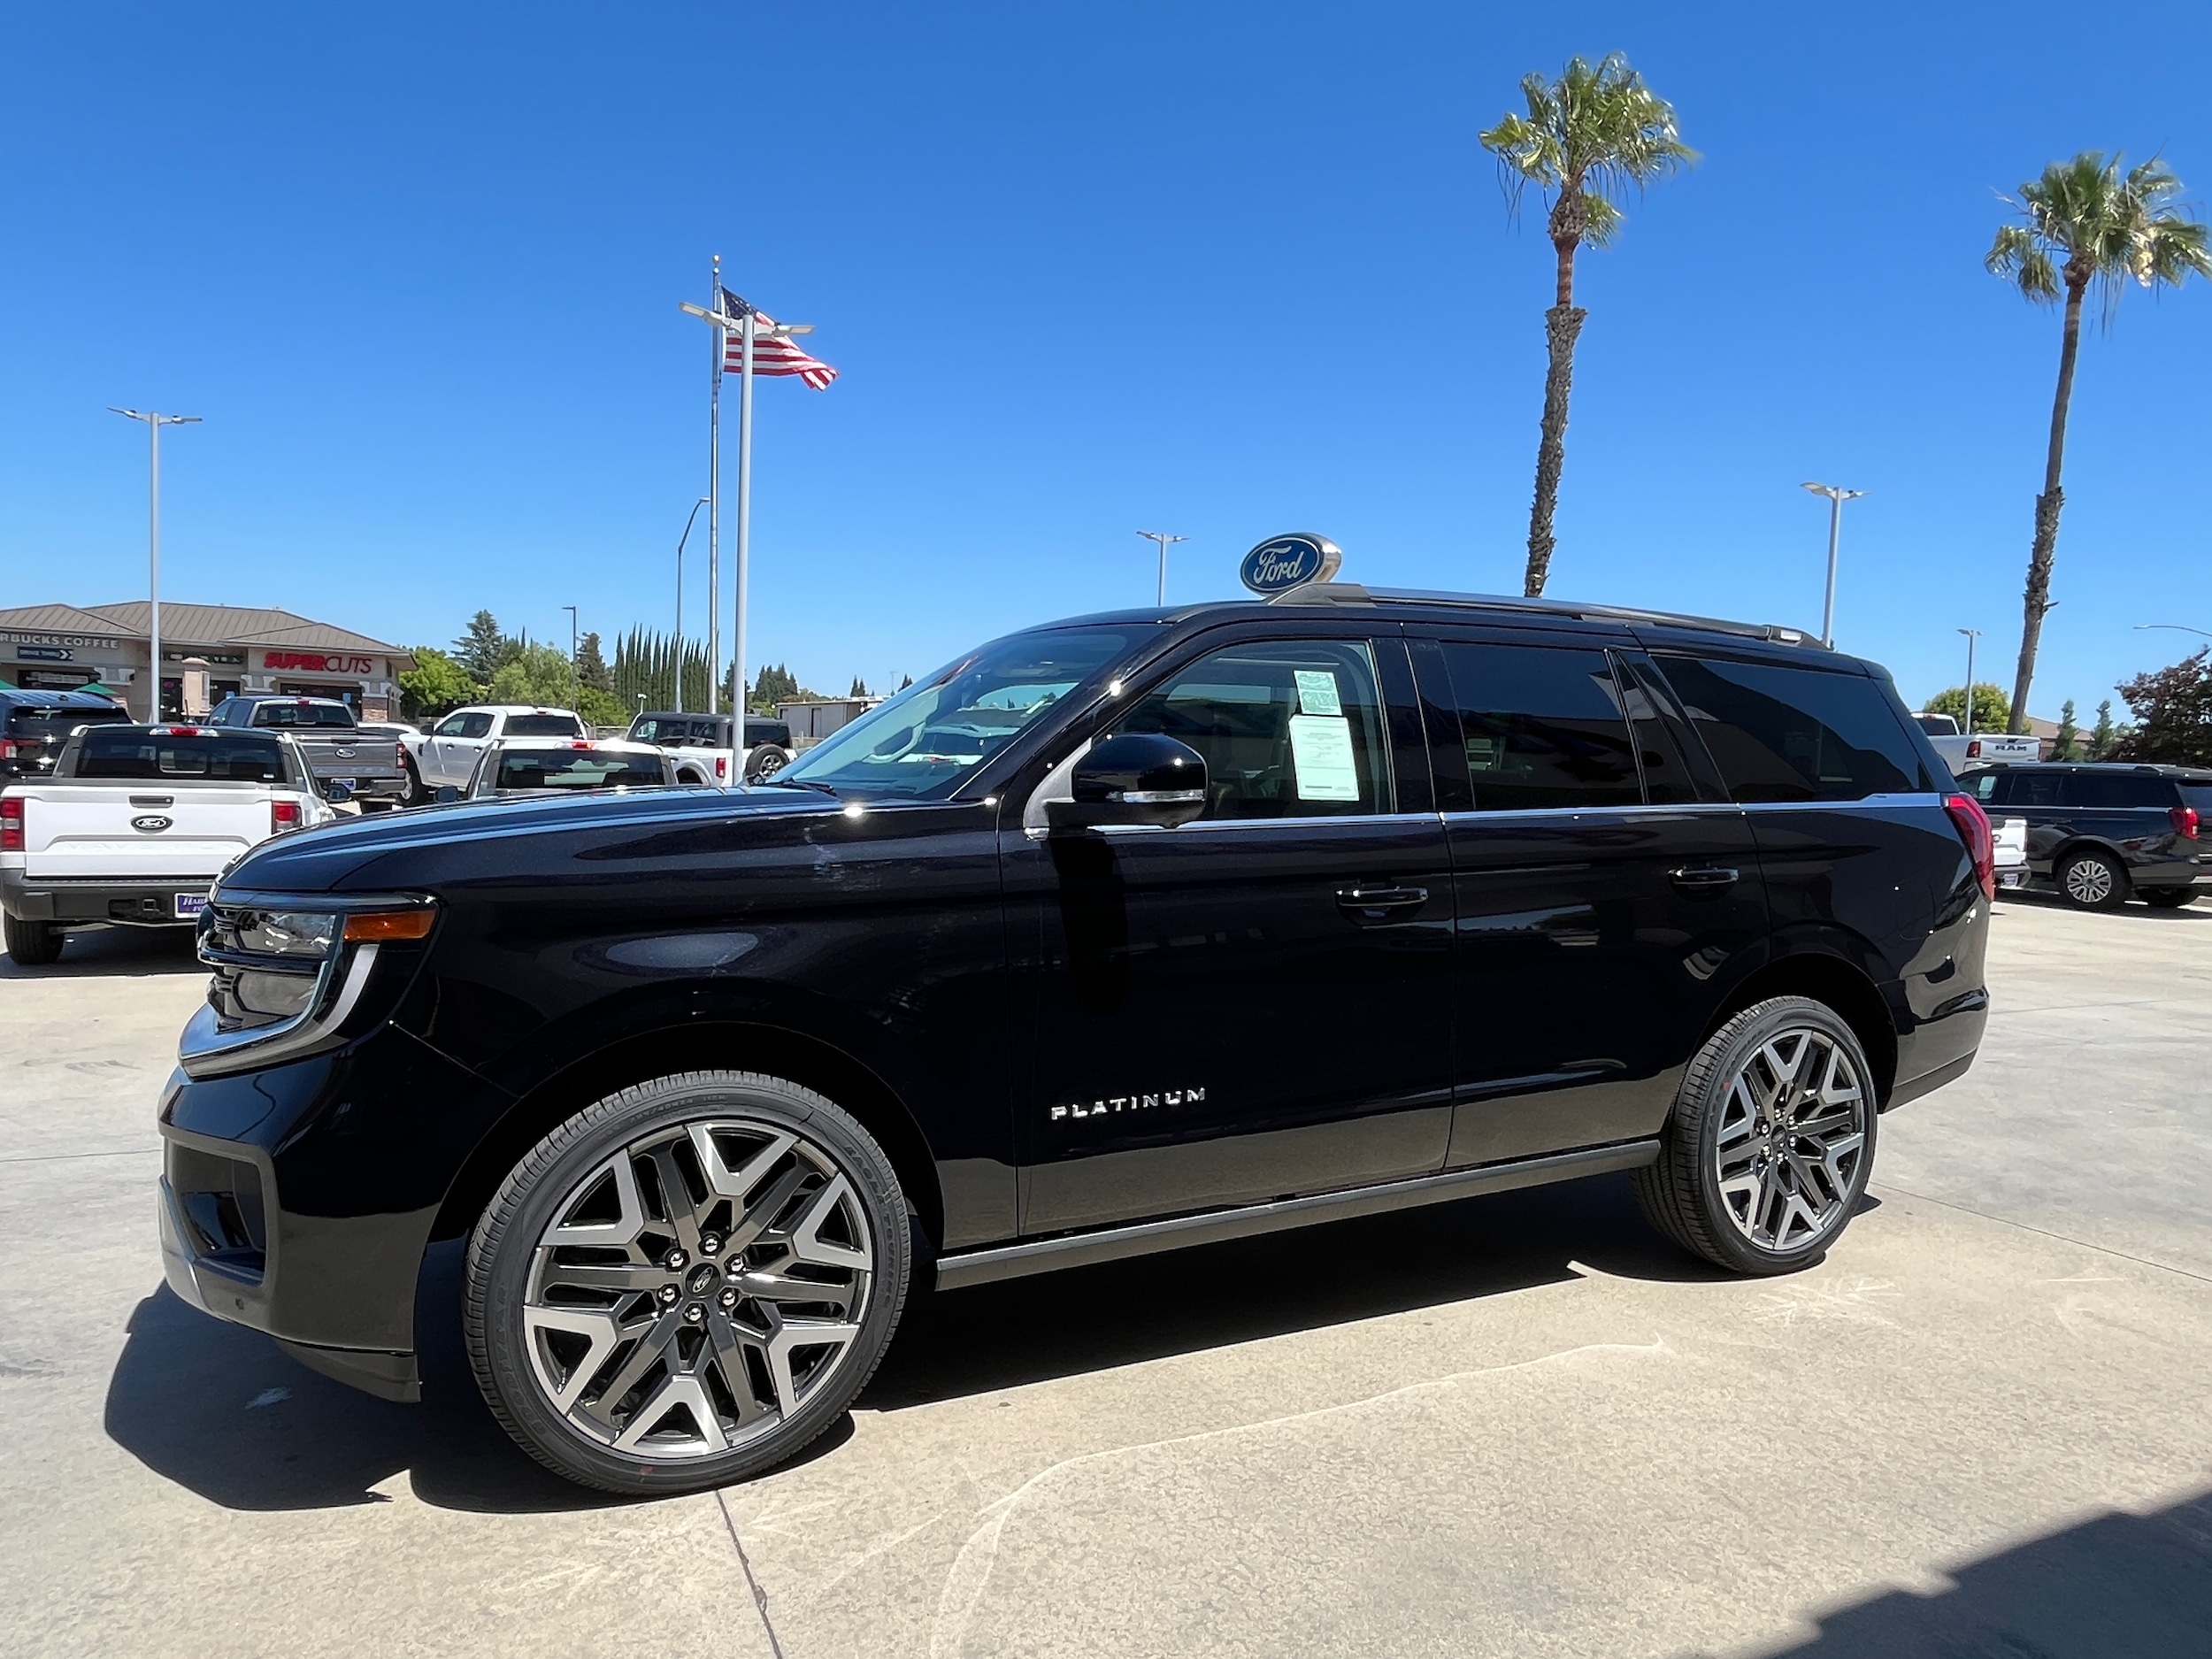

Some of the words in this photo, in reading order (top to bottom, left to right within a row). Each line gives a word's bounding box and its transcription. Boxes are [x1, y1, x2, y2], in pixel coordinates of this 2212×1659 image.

[1253, 545, 1305, 584] Ford
[0, 633, 59, 646] RBUCKS
[64, 637, 119, 649] COFFEE
[264, 652, 373, 673] SUPERCUTS
[1051, 1087, 1205, 1120] PLATINUM
